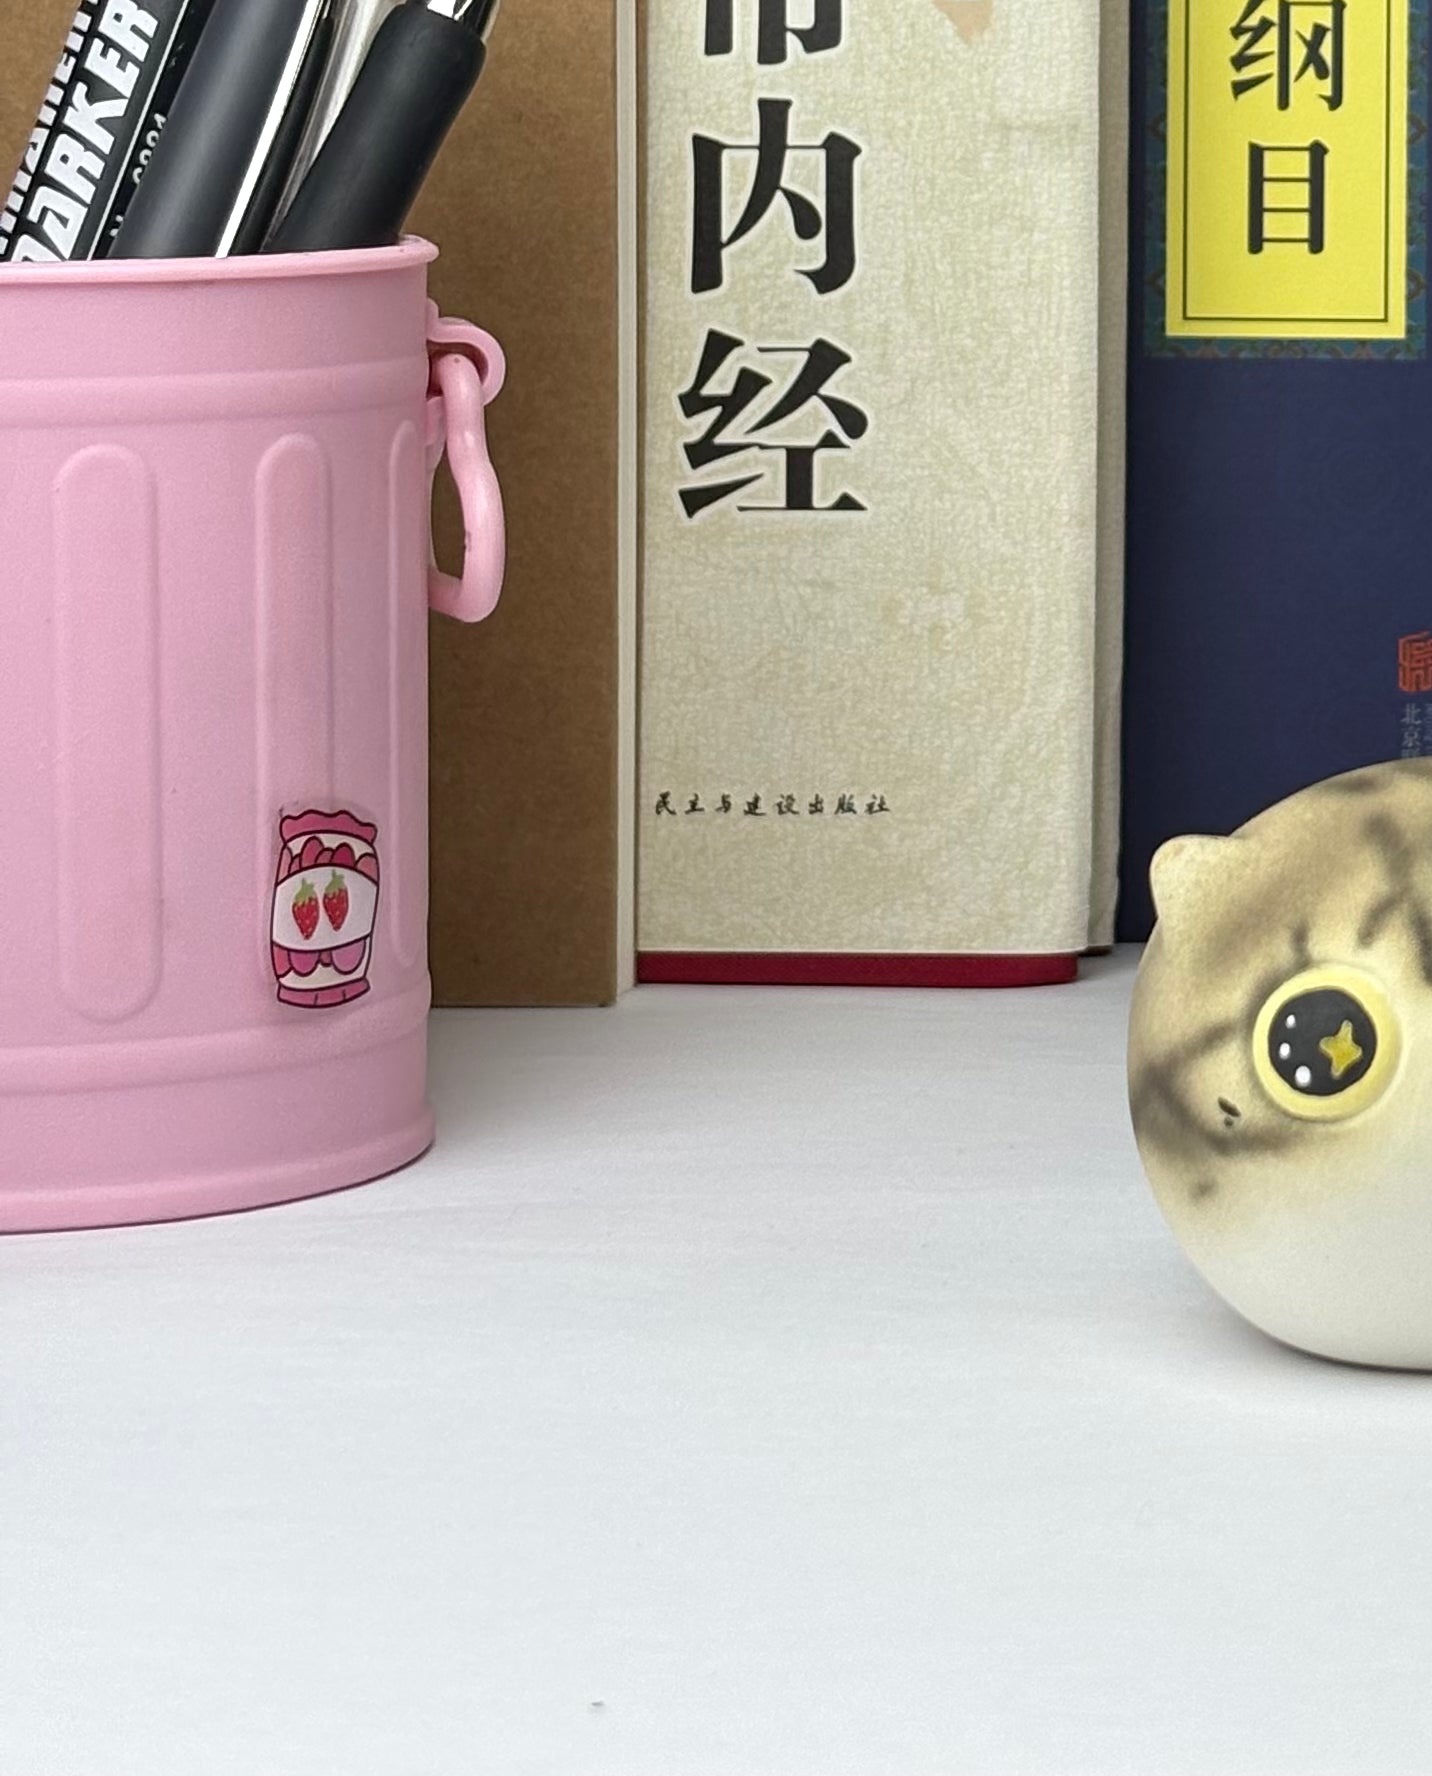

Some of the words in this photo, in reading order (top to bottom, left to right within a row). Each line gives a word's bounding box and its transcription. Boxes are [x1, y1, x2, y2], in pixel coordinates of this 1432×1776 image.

[655, 790, 892, 816] 民主与建设出版社
